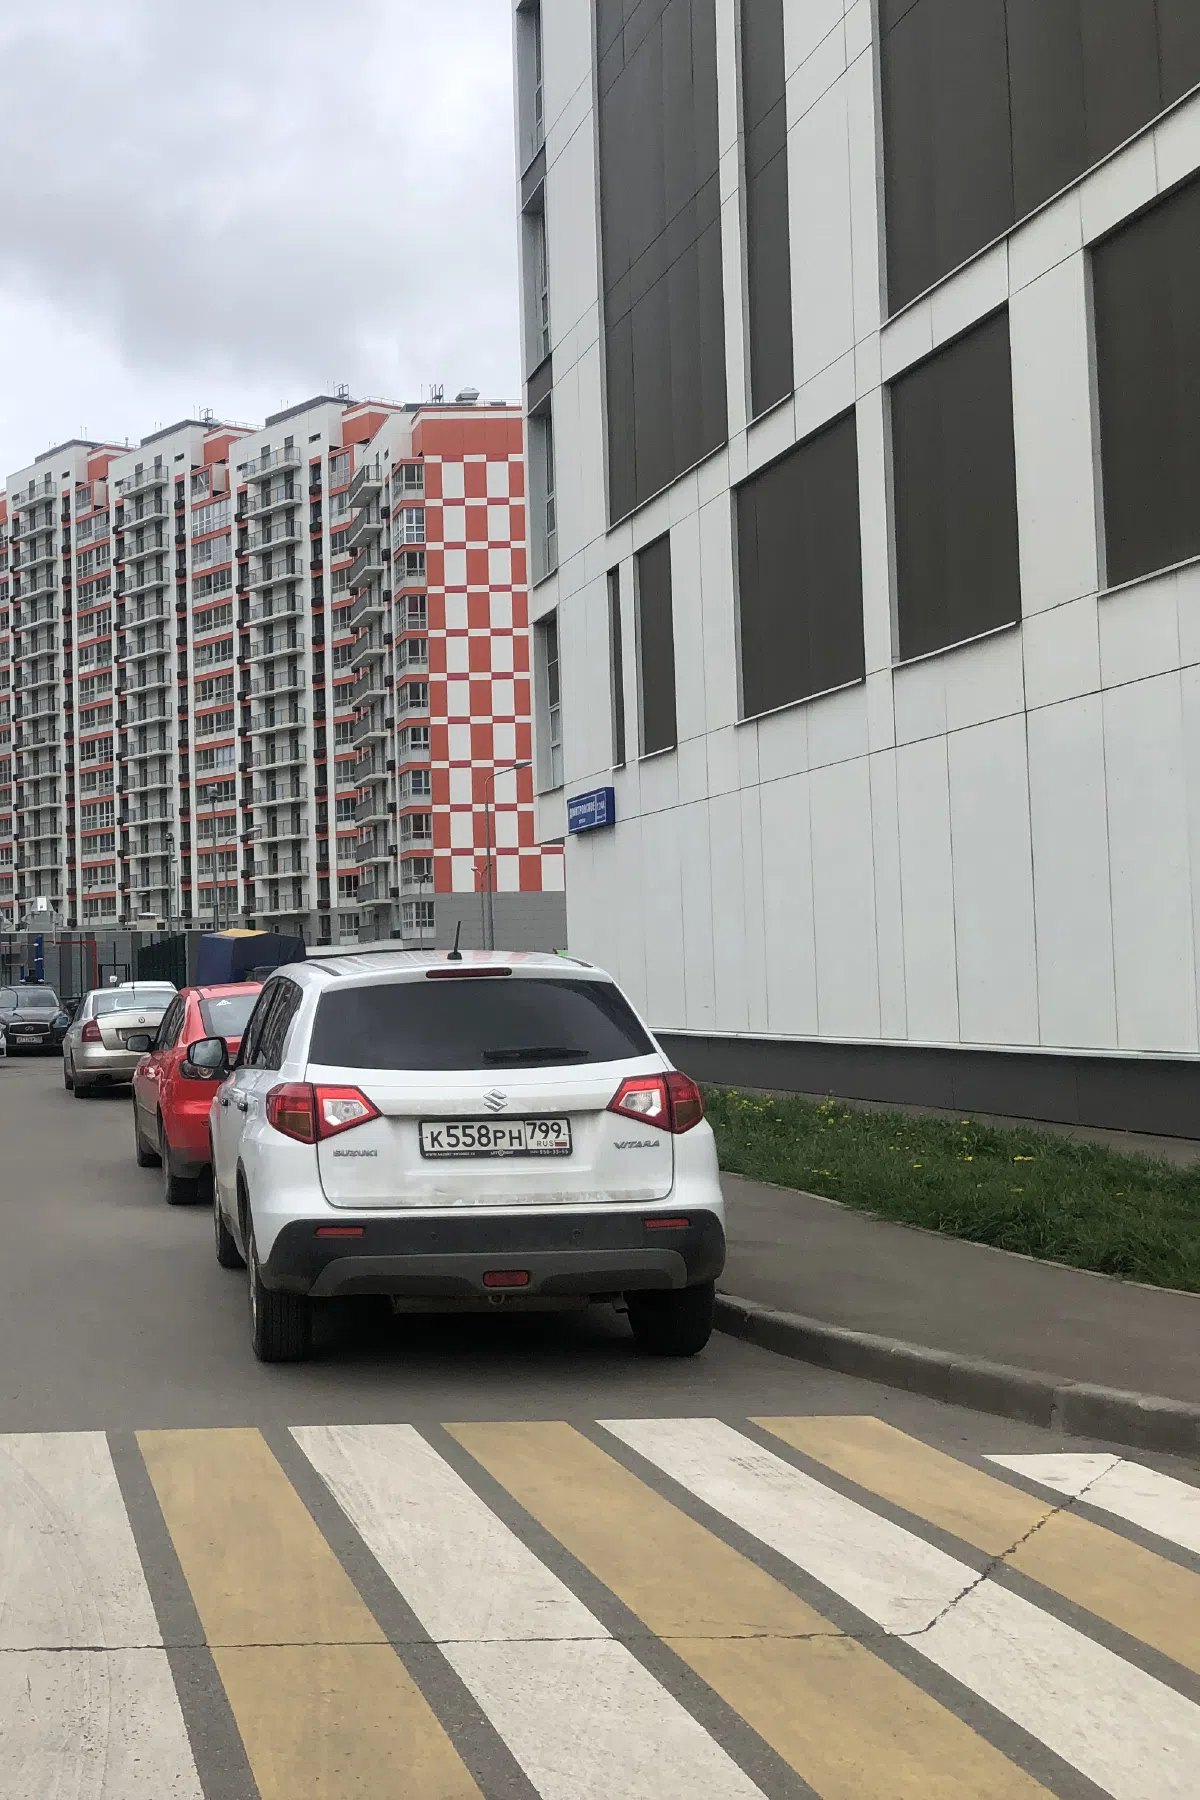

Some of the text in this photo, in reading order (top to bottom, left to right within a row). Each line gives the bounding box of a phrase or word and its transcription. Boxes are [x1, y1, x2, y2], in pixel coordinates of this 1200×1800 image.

[430, 1124, 523, 1148] К558РН
[526, 1122, 562, 1140] 799
[613, 1140, 660, 1149] VITARA
[332, 1149, 378, 1157] SUZUKI
